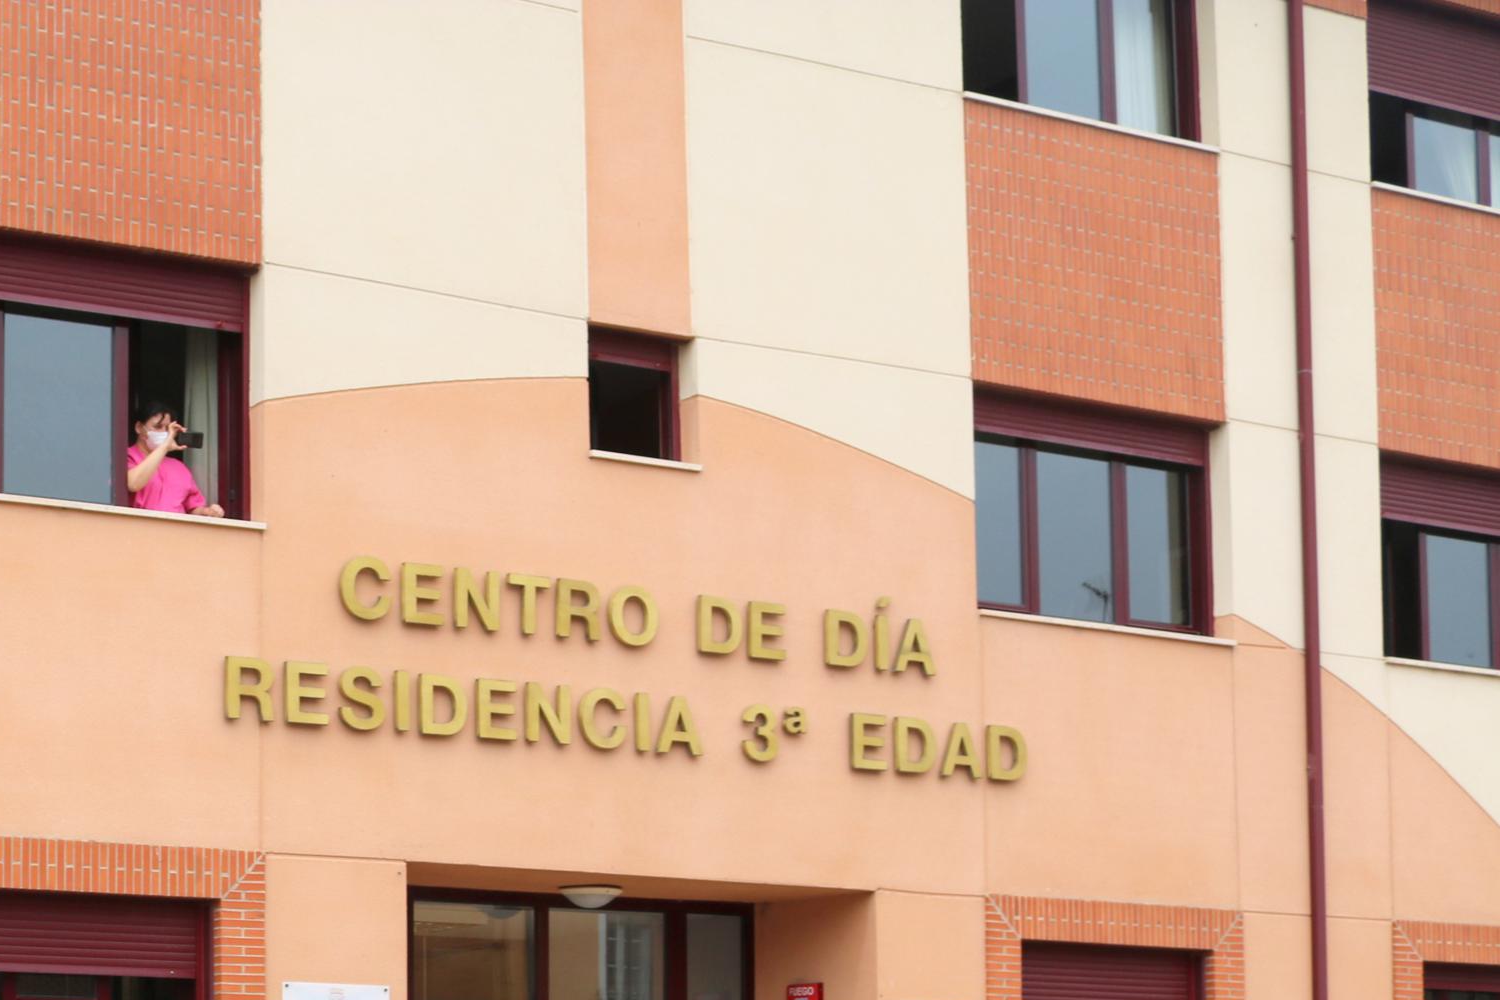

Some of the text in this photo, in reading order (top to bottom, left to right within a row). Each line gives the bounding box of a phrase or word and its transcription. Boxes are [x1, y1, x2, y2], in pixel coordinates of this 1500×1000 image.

[338, 555, 936, 677] CENTRO DE DÍA
[223, 655, 704, 757] RESIDENCIA
[848, 711, 1029, 782] EDAD
[789, 986, 815, 997] FUEGO
